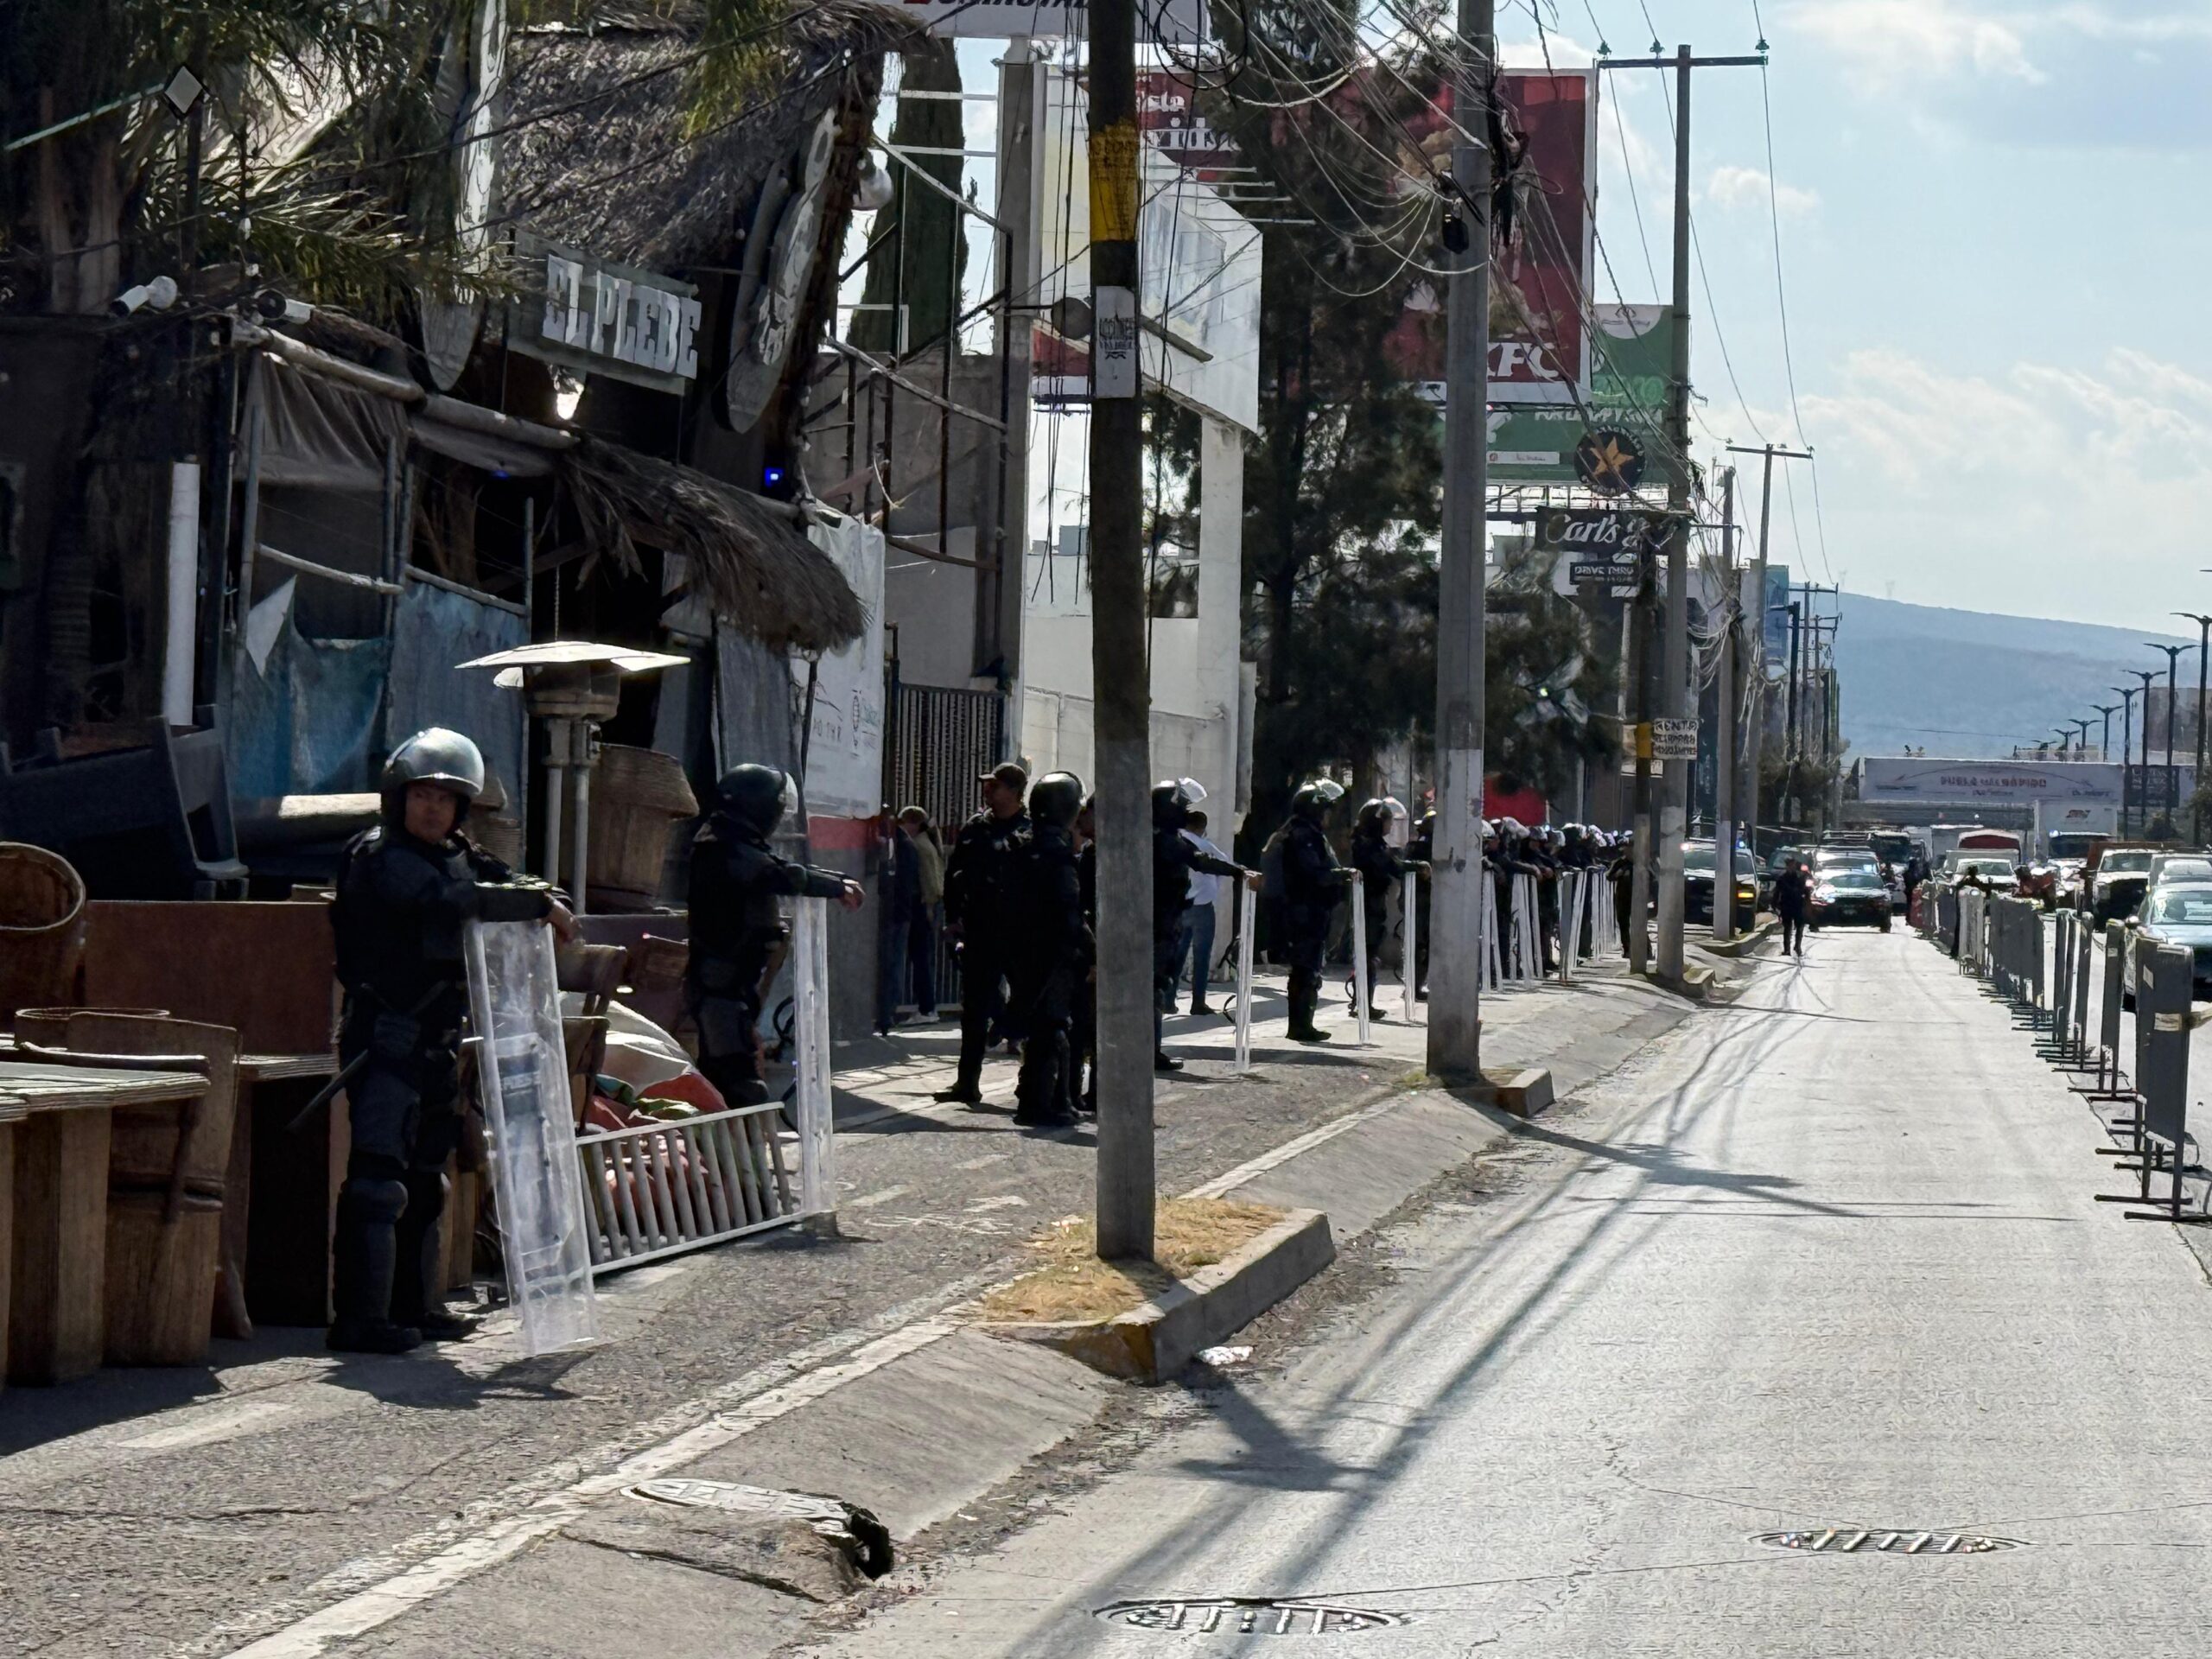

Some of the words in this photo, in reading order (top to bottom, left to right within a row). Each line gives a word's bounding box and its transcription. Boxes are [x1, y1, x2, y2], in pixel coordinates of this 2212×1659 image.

[543, 254, 588, 349] EL
[590, 270, 702, 379] PLEBE
[1546, 514, 1620, 543] Carl's
